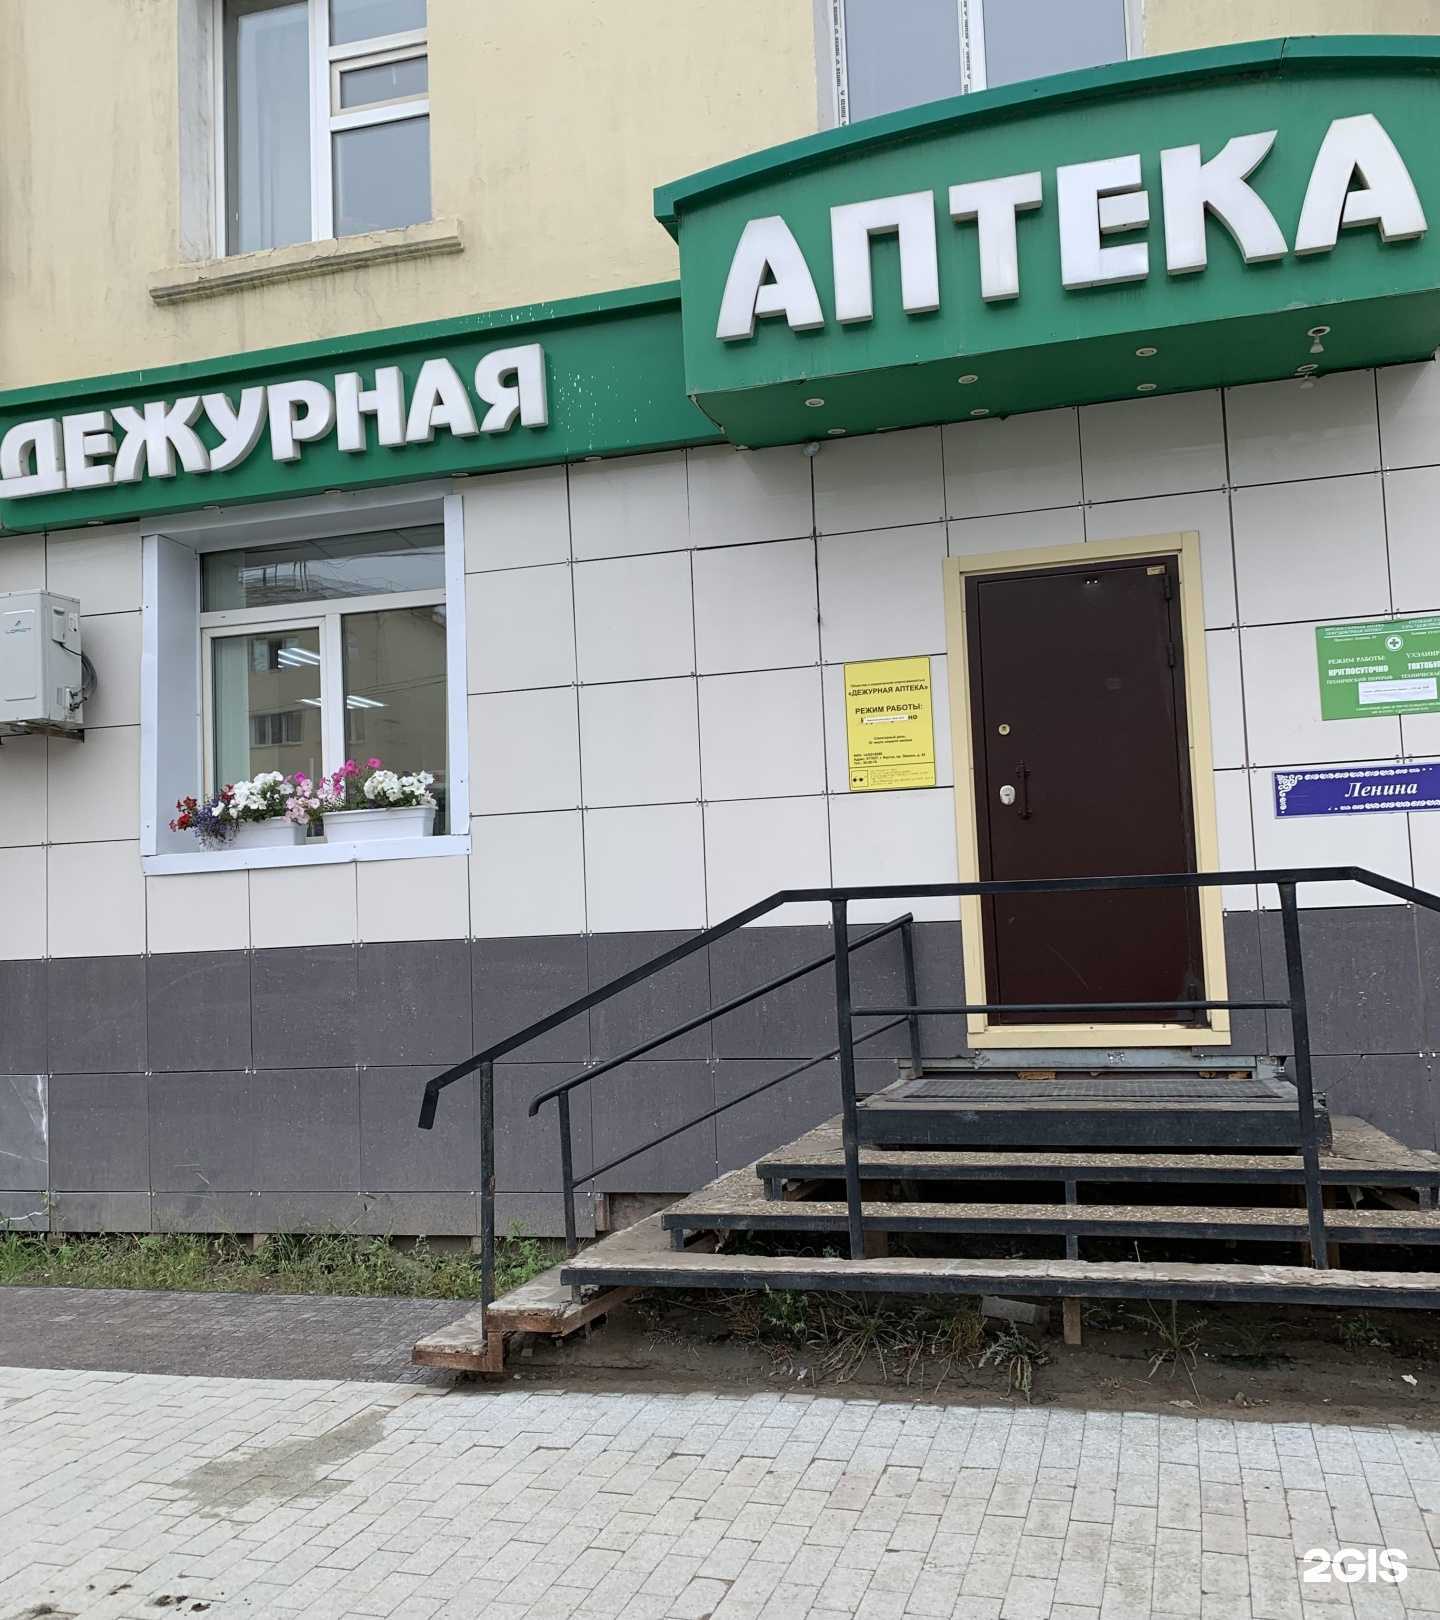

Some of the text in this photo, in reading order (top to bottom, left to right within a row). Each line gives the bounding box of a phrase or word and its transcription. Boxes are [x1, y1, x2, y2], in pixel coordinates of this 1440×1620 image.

[715, 113, 1428, 341] АПТЕКА
[0, 343, 549, 499] ДЕЖУРНАЯ
[848, 684, 929, 697] «ДЕЖУРНАЯ АПТЕКА»
[855, 705, 885, 715] РЕЖИМ
[1345, 782, 1418, 798] Ленина
